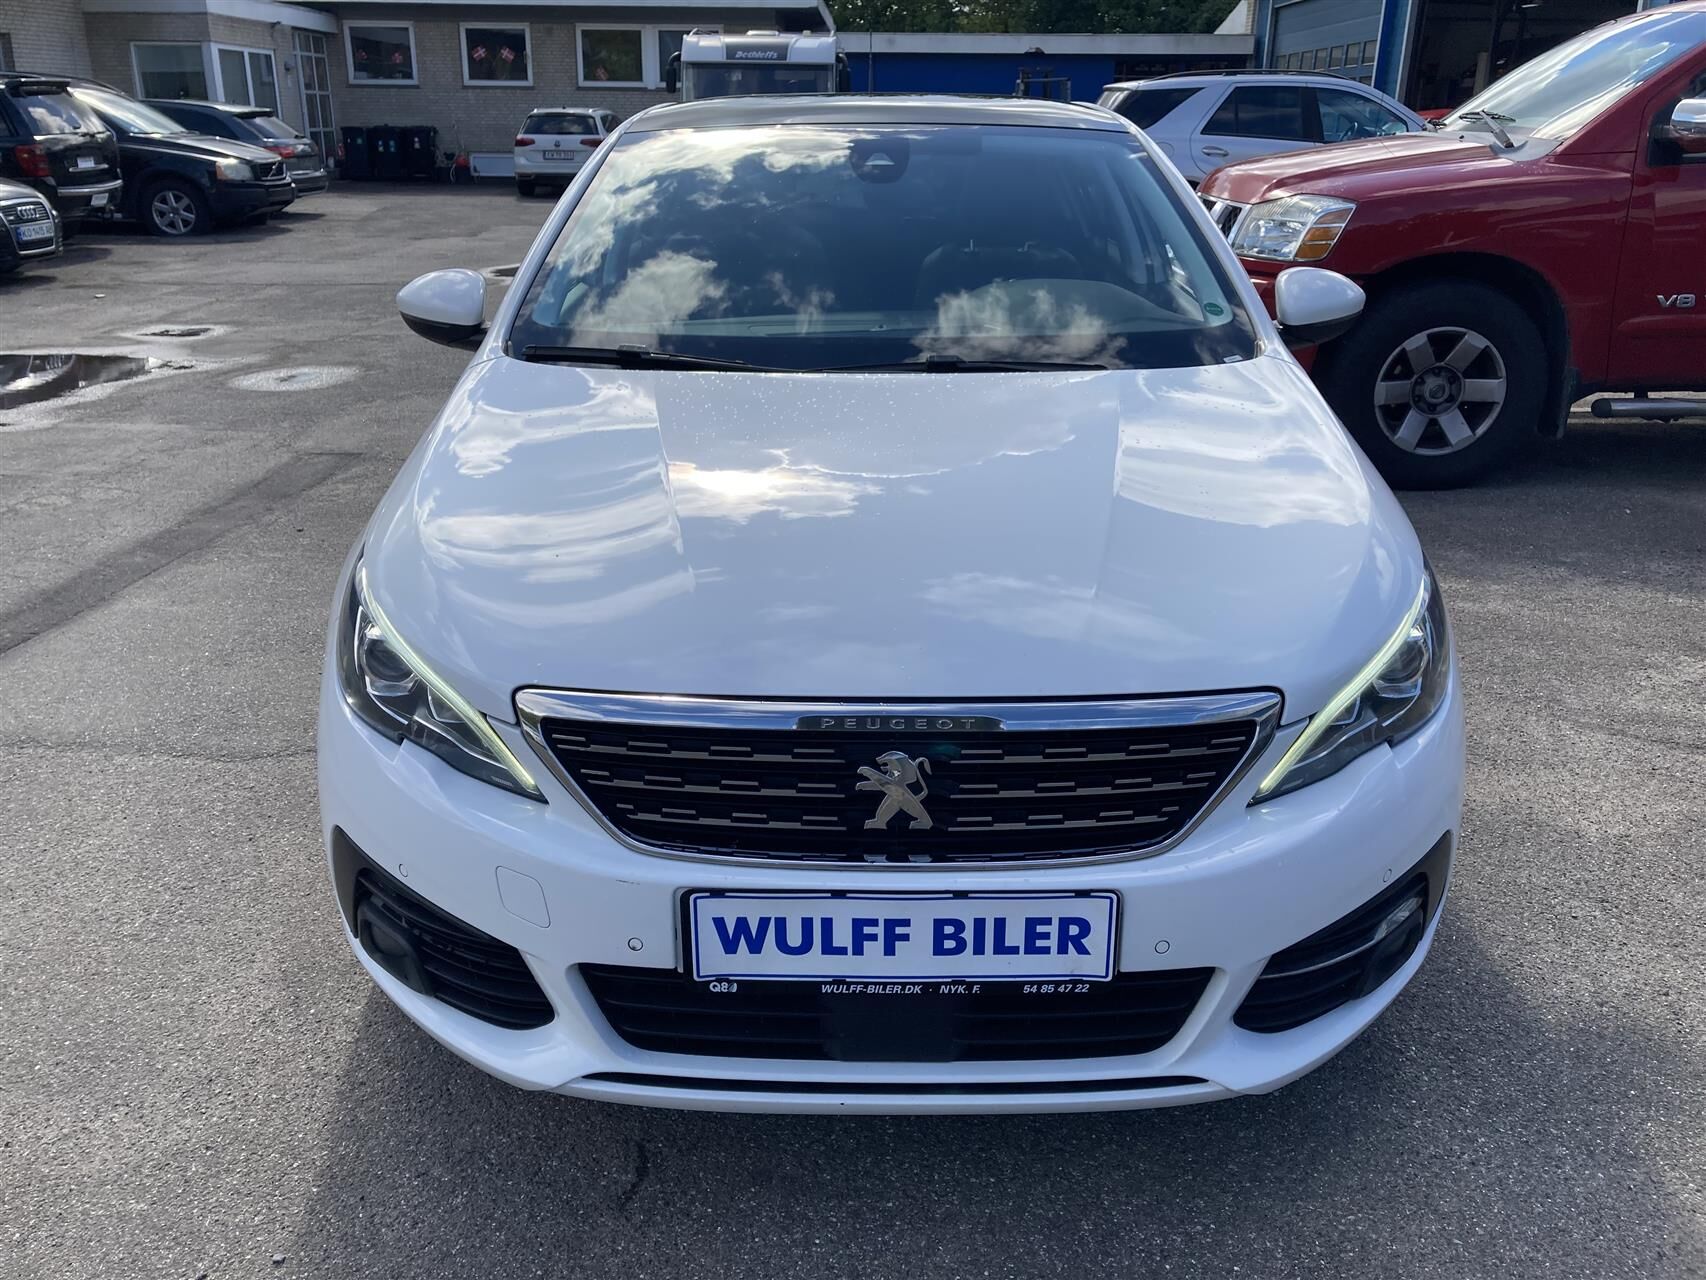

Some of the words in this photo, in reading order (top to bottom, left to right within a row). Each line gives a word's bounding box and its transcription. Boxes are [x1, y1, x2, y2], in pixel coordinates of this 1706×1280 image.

[1656, 294, 1696, 307] V8
[820, 718, 976, 730] PEUGEOT
[711, 916, 912, 957] WULFF
[932, 916, 1092, 957] BILER
[709, 981, 728, 993] Q8
[821, 984, 923, 994] WULFF-BILER.DK
[939, 984, 969, 994] NYK.
[972, 984, 981, 994] F.
[1023, 984, 1037, 994] 54
[1040, 984, 1055, 993] 85
[1057, 984, 1073, 993] 47
[1074, 983, 1090, 993] 22
